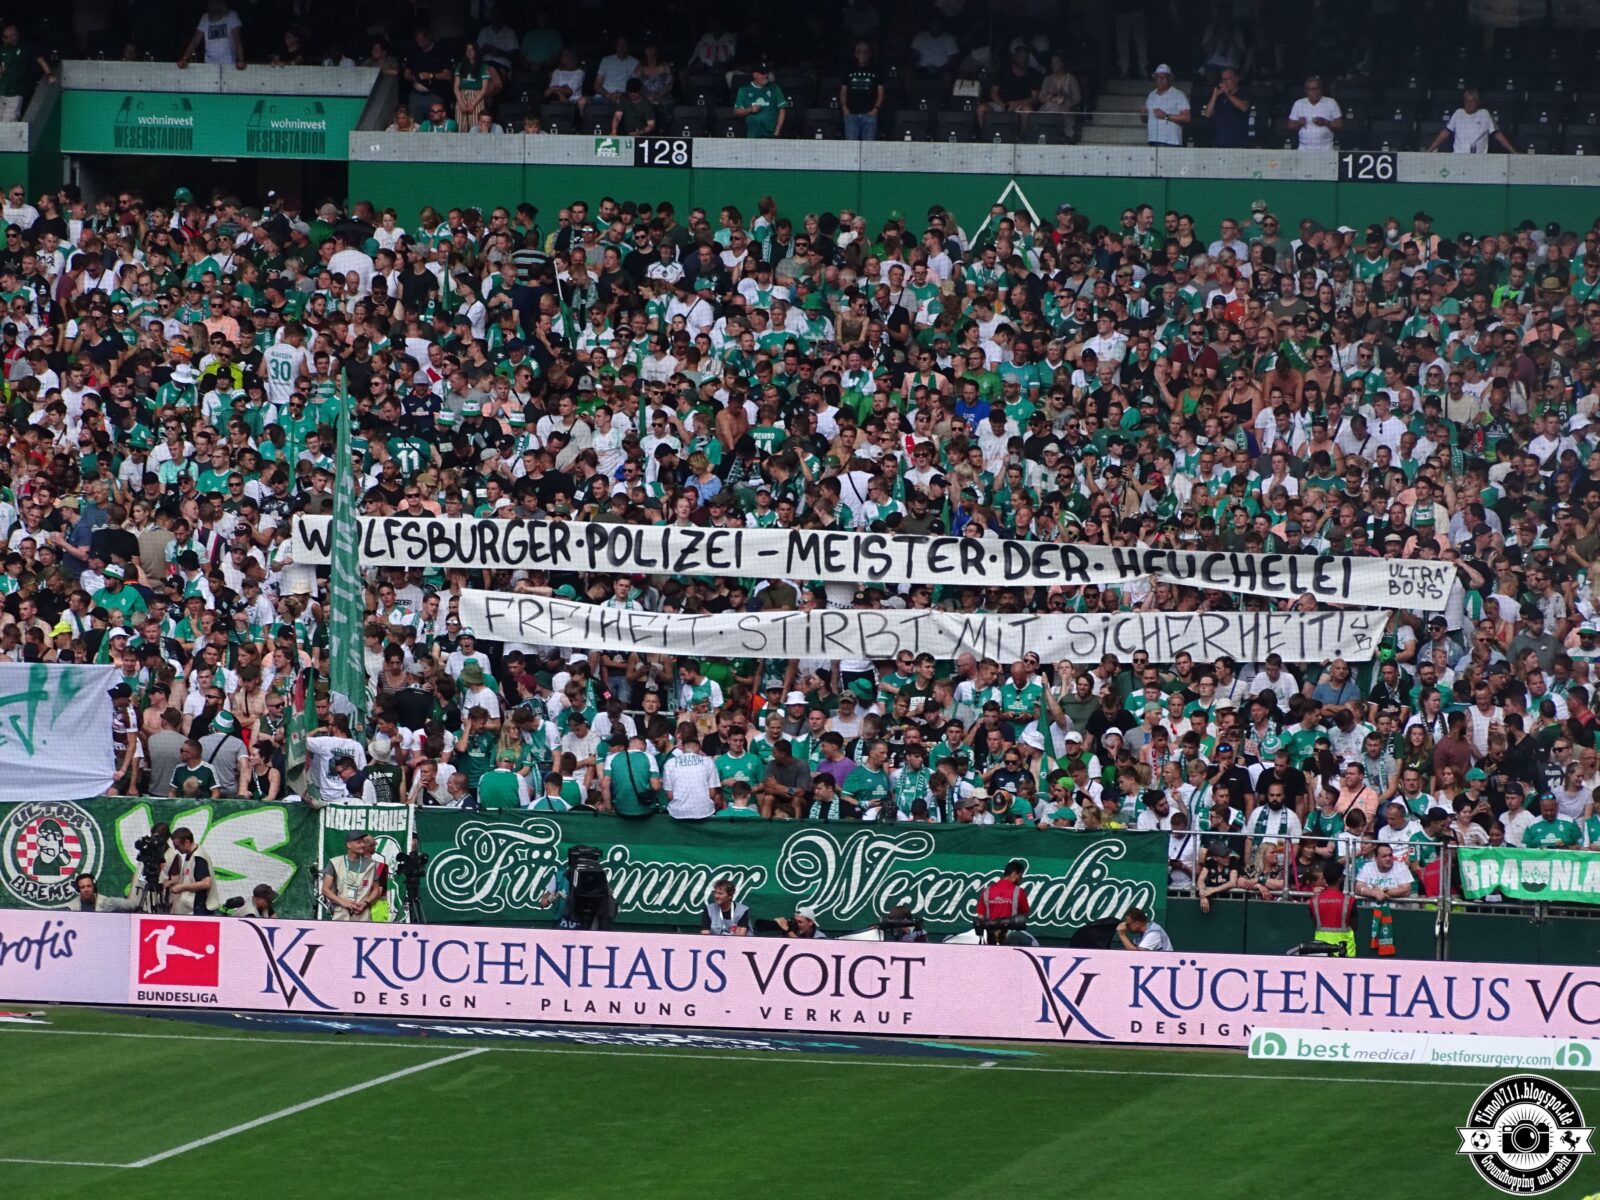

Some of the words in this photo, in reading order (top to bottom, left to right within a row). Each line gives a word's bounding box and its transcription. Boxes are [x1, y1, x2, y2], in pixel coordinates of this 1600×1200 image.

[138, 115, 193, 126] wohninvest
[270, 118, 326, 129] wohninvest
[114, 126, 193, 150] WESERSTADION
[246, 129, 326, 154] WESERSTADION
[639, 140, 688, 165] 128
[1342, 154, 1393, 179] 126
[270, 358, 292, 382] 30
[397, 450, 420, 473] 11
[299, 518, 571, 565] WLFSBURGER
[1389, 580, 1443, 600] BOYS
[326, 806, 367, 831] NAZIS
[368, 808, 408, 832] RAUS
[9, 874, 80, 901] BREME
[352, 931, 727, 993] KÜCHENHAUS
[742, 944, 926, 1000] VOIGT
[137, 990, 218, 1004] BUNDESLIGA
[1129, 959, 1511, 1022] KÜCHENHAUS
[354, 991, 477, 1009] DESIGN
[541, 998, 697, 1017] PLANUNG
[760, 1006, 913, 1025] VERKAUF
[1297, 1038, 1351, 1058] best
[1354, 1048, 1416, 1061] medical
[1432, 1048, 1551, 1068] bestforsurgery.com
